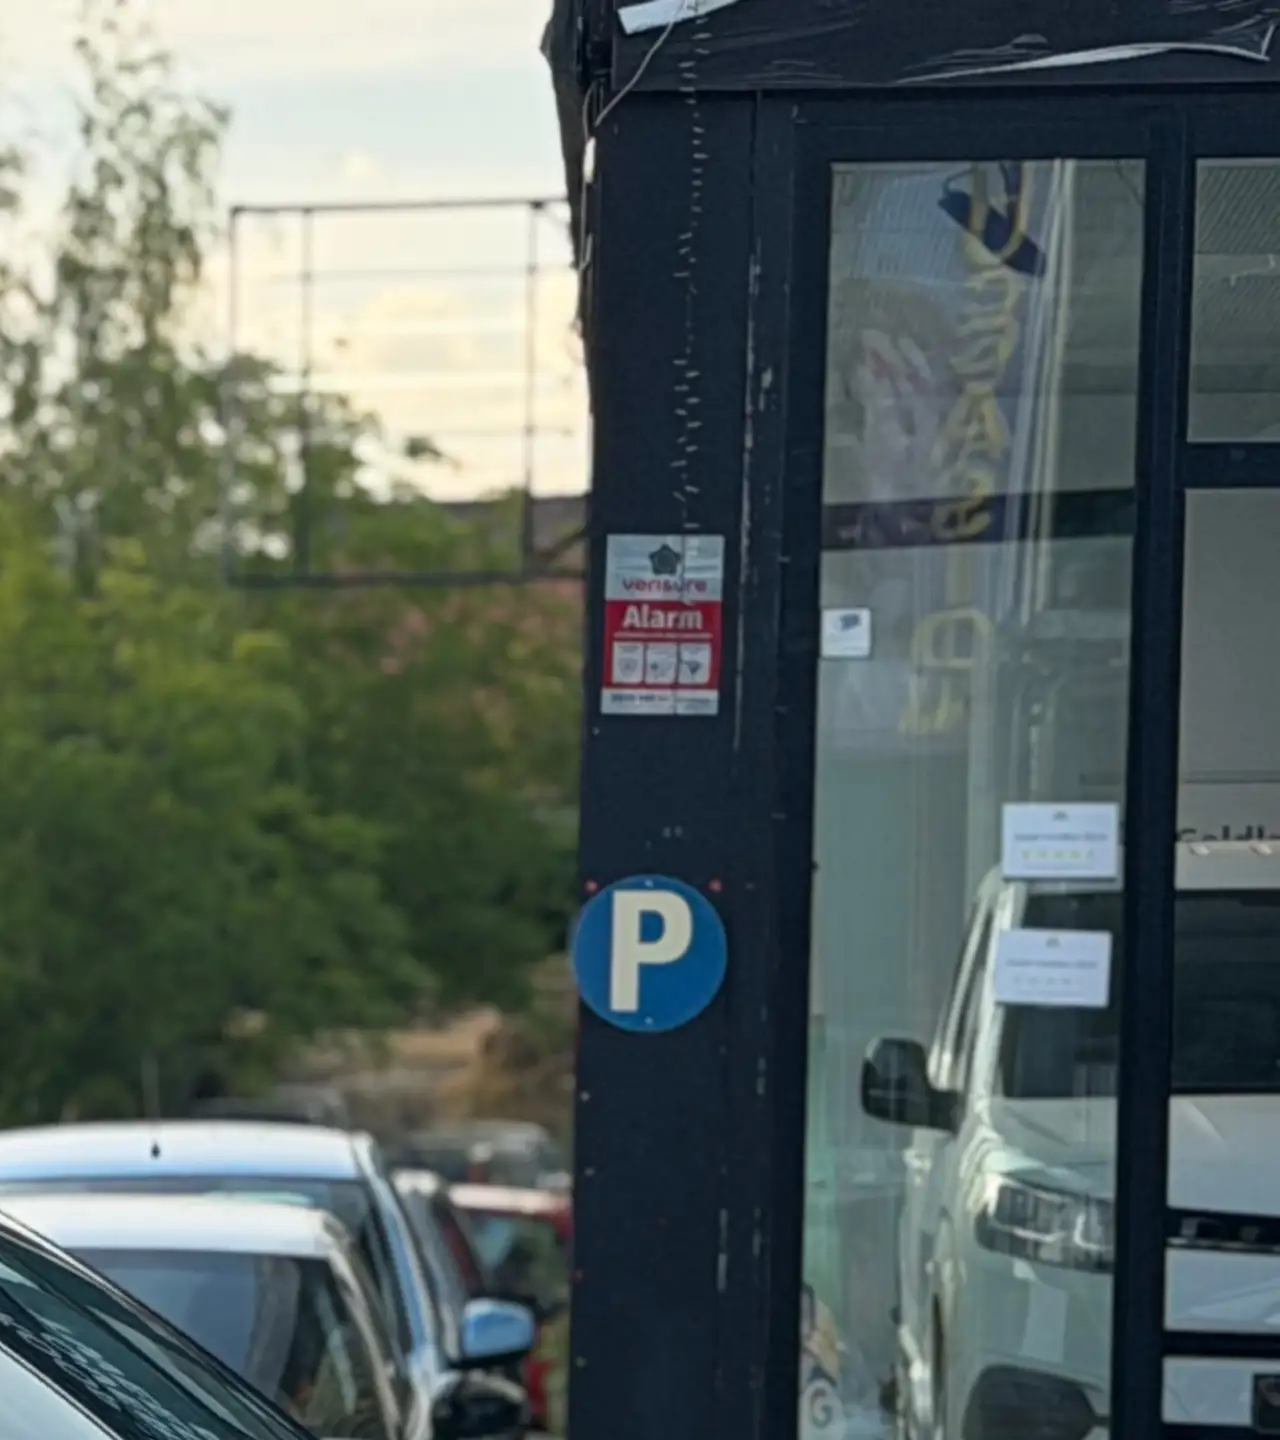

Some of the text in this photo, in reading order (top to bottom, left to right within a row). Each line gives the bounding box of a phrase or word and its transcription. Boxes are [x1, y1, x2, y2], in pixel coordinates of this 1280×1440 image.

[622, 576, 708, 593] verisure
[621, 604, 704, 630] Alarm
[611, 890, 693, 1013] P
